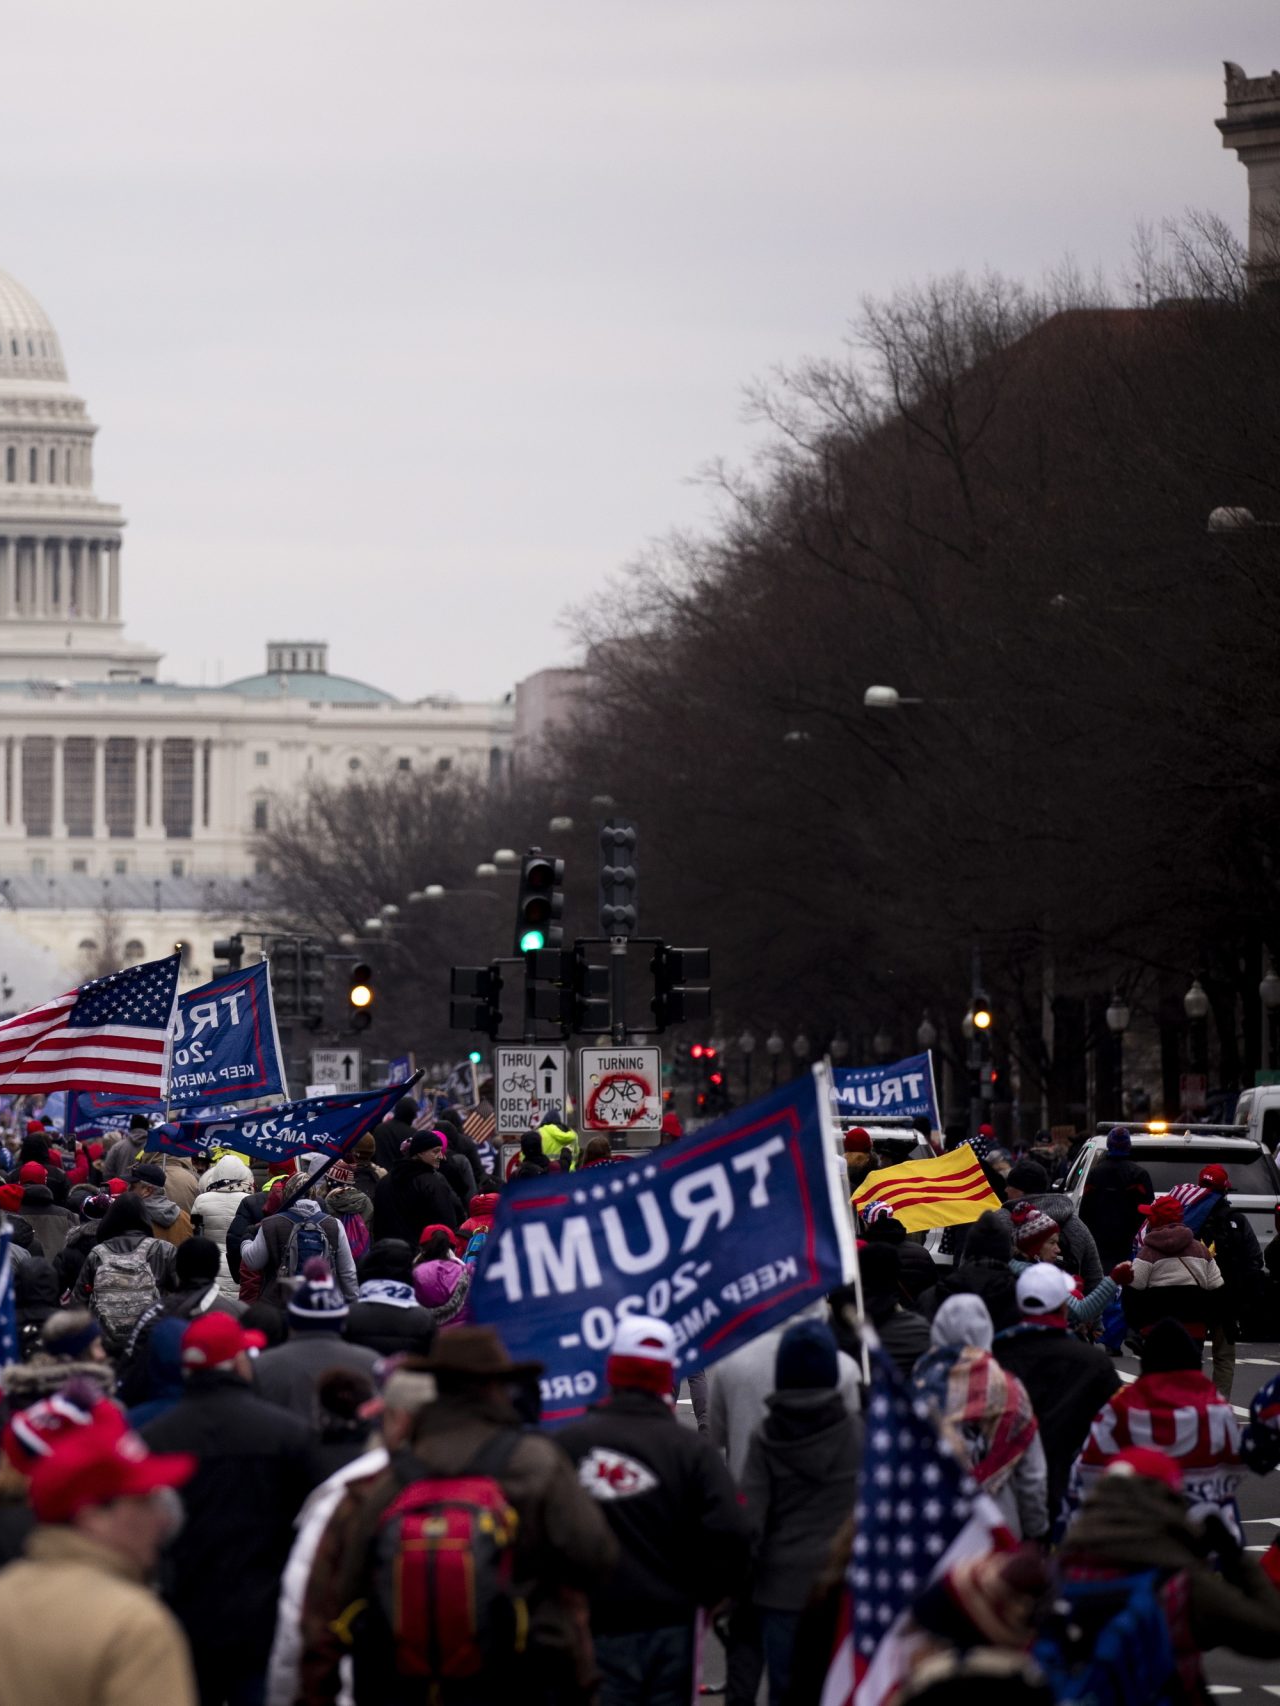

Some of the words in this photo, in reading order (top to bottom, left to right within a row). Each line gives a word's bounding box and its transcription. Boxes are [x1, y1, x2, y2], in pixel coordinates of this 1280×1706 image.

[501, 1053, 532, 1068] THRU
[597, 1057, 644, 1070] TURNING
[500, 1098, 530, 1112] OBEY
[537, 1098, 563, 1112] THIS
